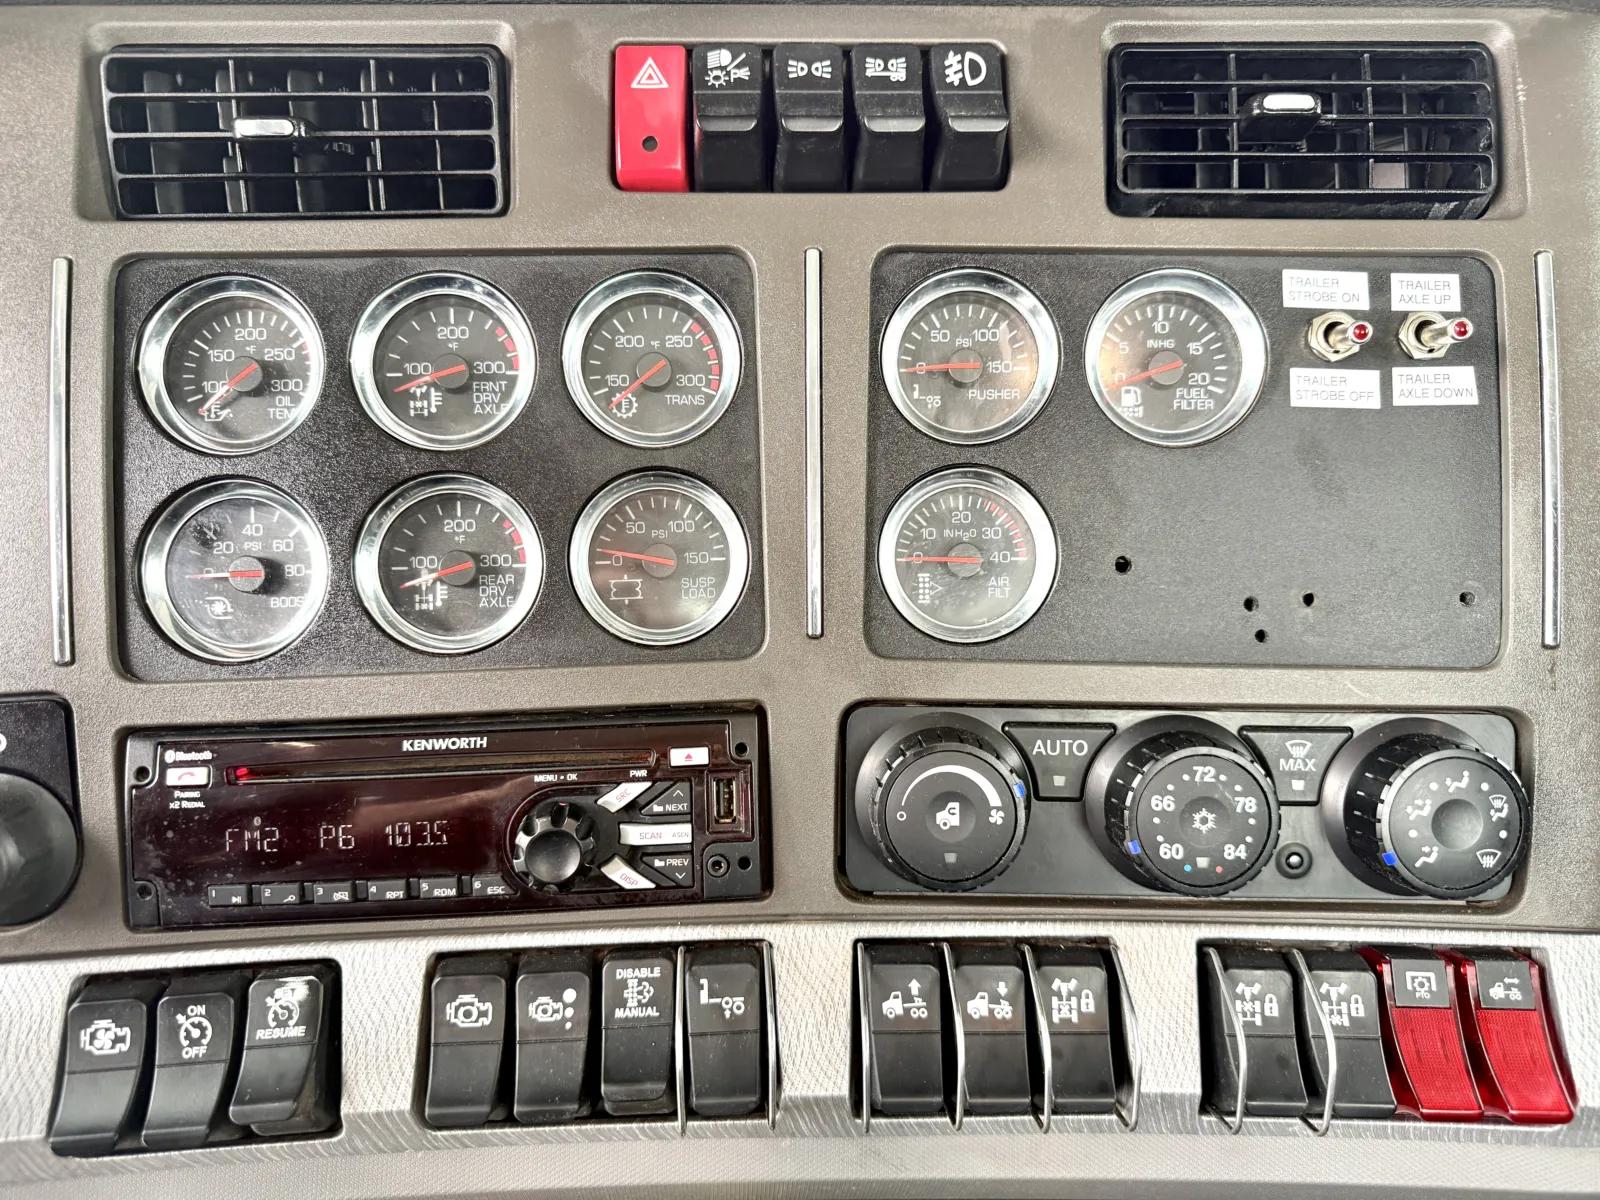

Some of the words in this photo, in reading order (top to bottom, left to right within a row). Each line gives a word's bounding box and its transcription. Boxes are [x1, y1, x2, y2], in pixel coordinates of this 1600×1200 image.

[1289, 276, 1340, 289] TRAILER
[1398, 279, 1451, 291] TRAILER
[1288, 290, 1338, 302] STROBE
[1341, 292, 1360, 303] ON
[1398, 294, 1431, 304] AXLE
[1434, 294, 1452, 305] UP
[437, 327, 469, 339] 200
[1152, 321, 1169, 334] 10
[235, 328, 267, 341] 200
[930, 330, 950, 343] 50
[972, 329, 1000, 342] 100
[615, 335, 644, 348] 200
[666, 335, 693, 348] 250
[955, 338, 973, 347] PSI
[1119, 342, 1129, 354] 5
[1187, 342, 1203, 355] 15
[208, 350, 235, 362] 150
[264, 349, 295, 361] 250
[404, 363, 432, 375] 100
[473, 362, 505, 374] 300
[915, 362, 927, 374] 0
[986, 360, 1012, 373] 150
[605, 375, 630, 387] 150
[676, 375, 705, 387] 300
[1188, 373, 1210, 385] 20
[1296, 375, 1348, 387] TRAILER
[1398, 373, 1451, 384] TRAILER
[271, 379, 303, 392] 300
[473, 381, 508, 392] FRNT
[473, 392, 501, 404] DRV
[968, 389, 1020, 400] PUSHER
[1176, 388, 1209, 399] FUEL
[1295, 389, 1345, 401] STROBE
[1350, 391, 1375, 402] OFF
[1398, 388, 1429, 398] AXLE
[1434, 388, 1473, 398] DOWN
[276, 395, 295, 407] OIL
[665, 395, 705, 406] TRANS
[1173, 399, 1214, 410] FILTER
[267, 408, 297, 420] TEM
[951, 511, 971, 524] 20
[241, 524, 263, 537] 40
[443, 519, 476, 532] 200
[625, 522, 646, 534] 50
[668, 521, 695, 533] 100
[651, 529, 668, 538] PSI
[920, 528, 936, 539] 10
[982, 527, 1002, 539] 30
[213, 542, 234, 554] 20
[244, 542, 262, 551] PSI
[273, 539, 294, 552] 60
[409, 556, 438, 569] 100
[480, 554, 512, 567] 300
[612, 555, 623, 566] 0
[683, 552, 709, 564] 150
[912, 551, 924, 564] 0
[989, 551, 1011, 563] 40
[285, 564, 305, 577] 80
[479, 575, 514, 585] REAR
[681, 577, 715, 588] SUSP
[988, 576, 1010, 587] AIR
[479, 586, 507, 597] DRV
[681, 588, 716, 599] LOAD
[988, 587, 1010, 598] FILT
[271, 596, 305, 608] BOOS
[479, 597, 515, 608] AXLE
[402, 736, 488, 752] KENWORTH
[1032, 739, 1089, 756] AUTO
[1279, 758, 1316, 772] MAX
[534, 774, 558, 783] MENU
[566, 773, 578, 781] OK
[629, 769, 648, 778] PWR
[1192, 766, 1216, 782] 72
[615, 788, 633, 803] SRC
[665, 803, 688, 812] NEXT
[1150, 795, 1176, 812] 66
[1234, 796, 1257, 813] 78
[226, 826, 279, 852] FM2
[320, 824, 355, 849] P6
[639, 832, 662, 840] SCAN
[1159, 843, 1184, 860] 60
[1223, 843, 1247, 860] 84
[666, 858, 690, 867] PREV
[474, 881, 482, 889] 6
[619, 872, 639, 887] DISP
[264, 888, 271, 897] 2
[316, 887, 324, 895] 3
[369, 885, 377, 893] 4
[421, 882, 429, 891] 5
[433, 888, 456, 897] RDM
[487, 886, 506, 895] ESC
[386, 891, 404, 899] RPT
[615, 966, 661, 980] DISABLE
[187, 1005, 206, 1016] ON
[614, 1006, 660, 1019] MANUAL
[256, 1026, 306, 1040] RESUME
[182, 1046, 207, 1059] OFF
